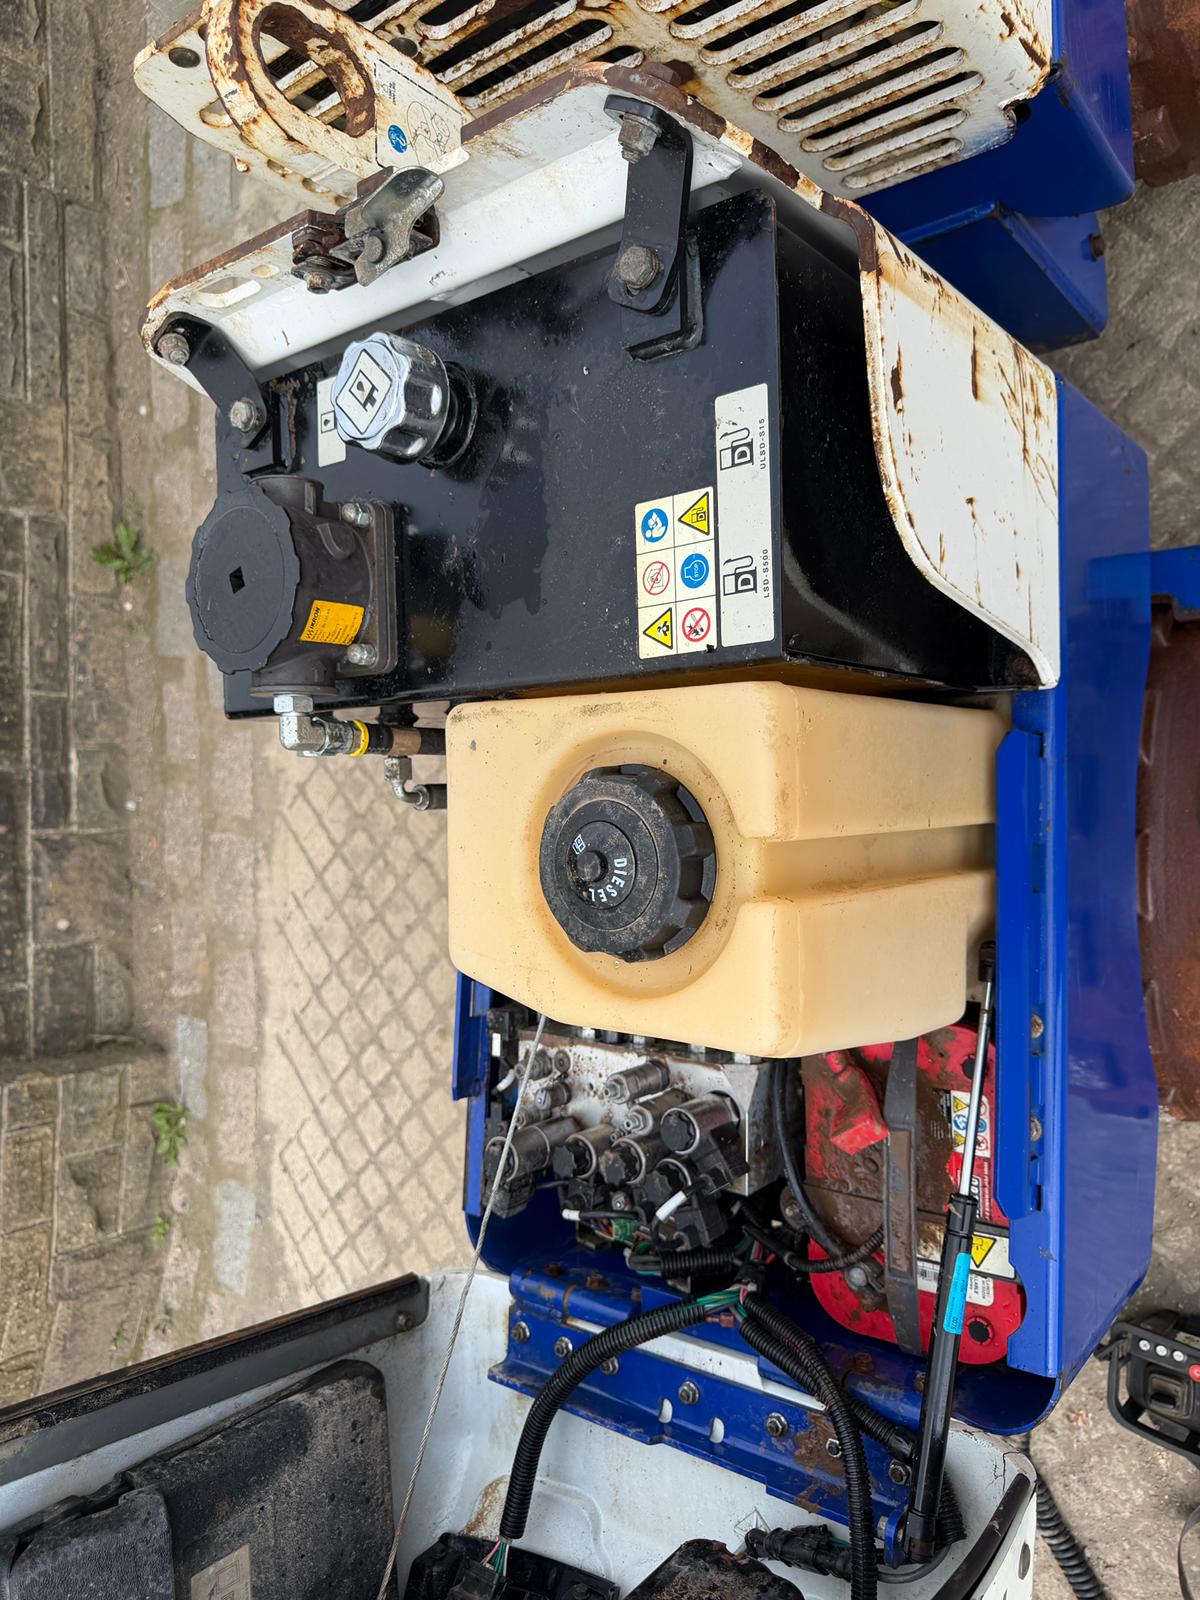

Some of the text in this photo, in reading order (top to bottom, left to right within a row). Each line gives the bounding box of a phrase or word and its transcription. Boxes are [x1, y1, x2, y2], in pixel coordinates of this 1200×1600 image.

[734, 446, 750, 465] D
[759, 418, 767, 470] ULSD-S15
[738, 573, 754, 591] D
[762, 548, 770, 598] LSD-S500
[588, 858, 628, 902] DIESEL
